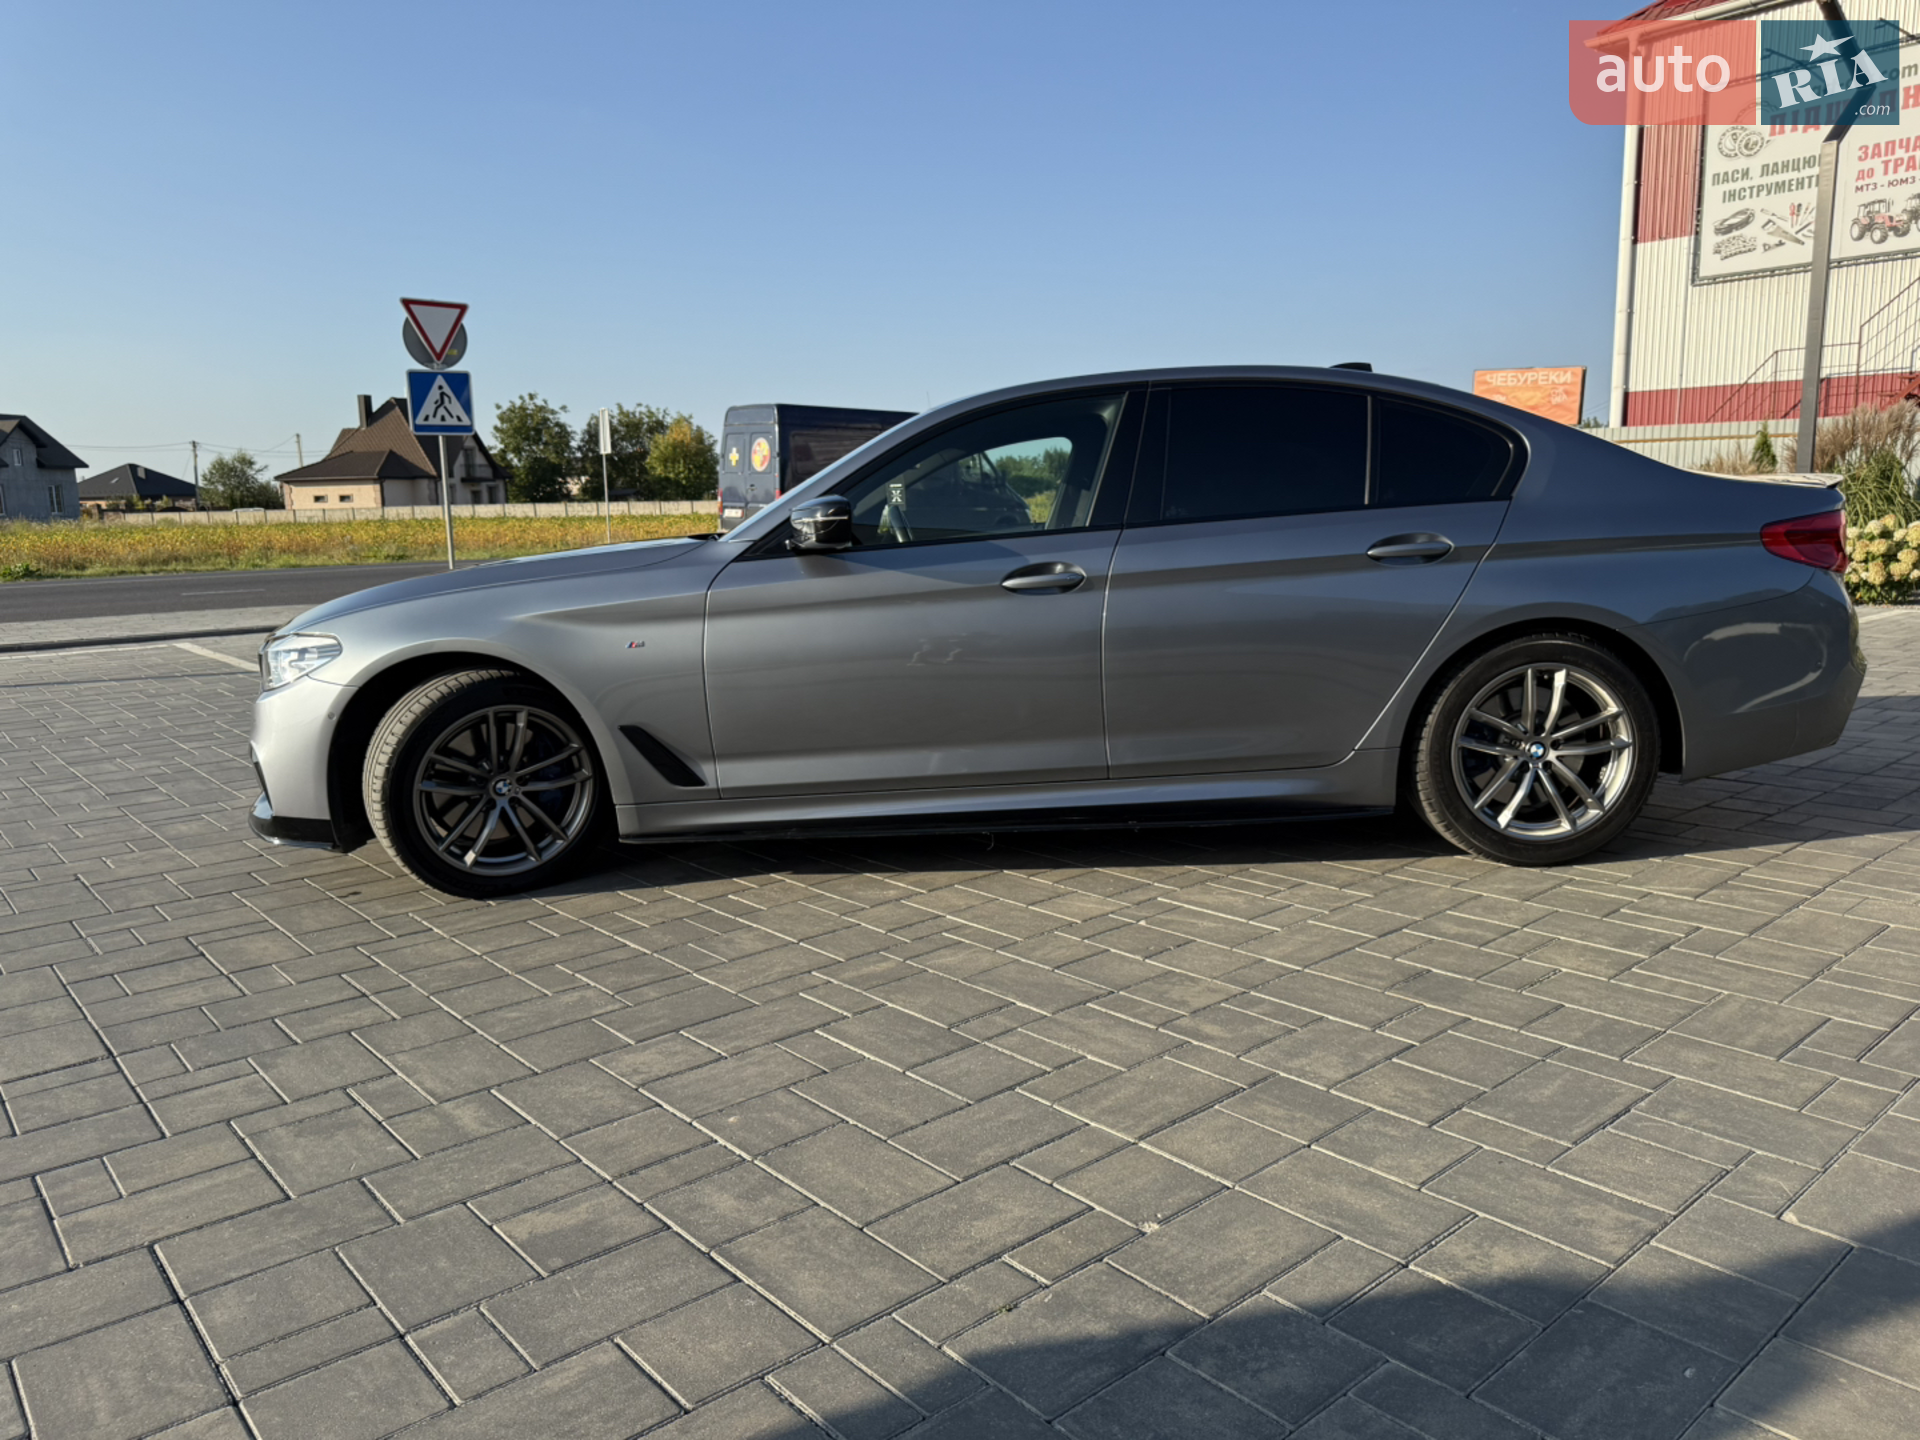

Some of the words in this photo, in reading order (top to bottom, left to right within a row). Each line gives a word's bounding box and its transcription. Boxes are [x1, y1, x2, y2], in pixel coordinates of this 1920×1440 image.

[1881, 154, 1920, 176] ТРА
[1711, 167, 1753, 186] ПАСИ,
[1486, 371, 1572, 386] ЧЕБУРЕКИ
